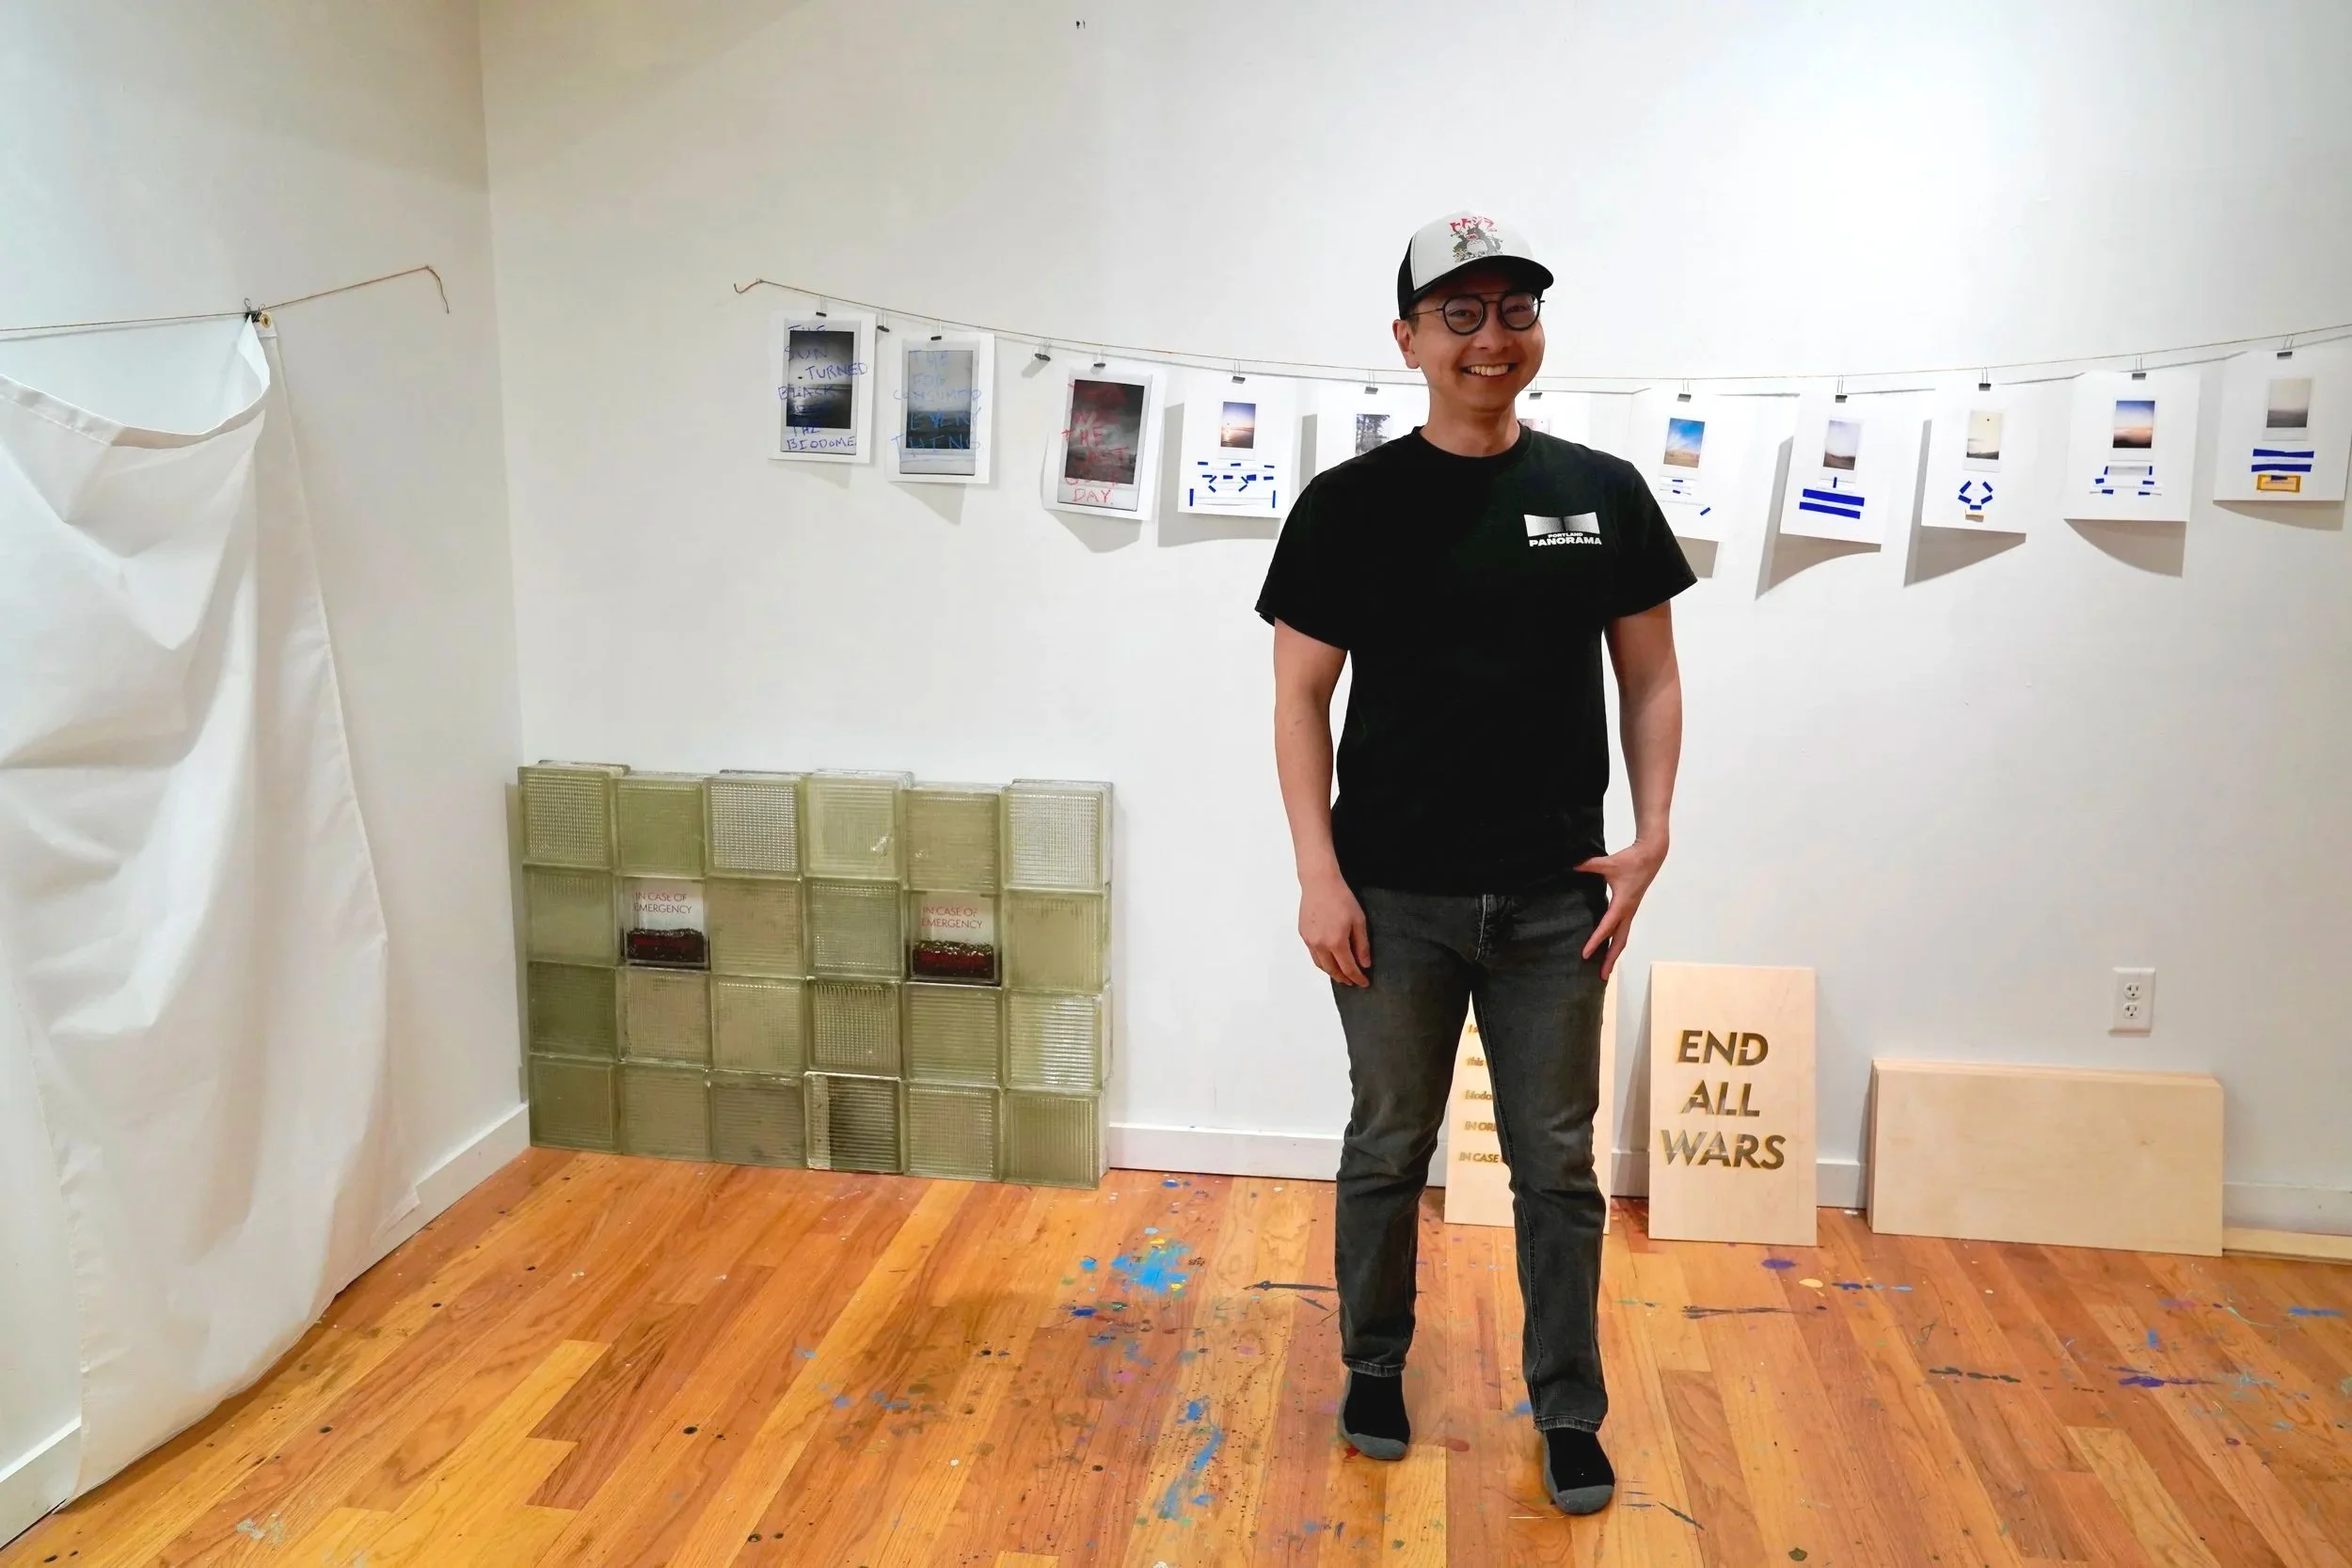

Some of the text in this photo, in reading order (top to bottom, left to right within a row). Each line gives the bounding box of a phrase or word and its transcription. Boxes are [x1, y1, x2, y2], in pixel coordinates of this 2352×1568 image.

[805, 362, 867, 380] TURNED
[1529, 536, 1602, 546] PANORAMA
[635, 892, 687, 902] IN CASE OF
[634, 903, 692, 914] EMERGENCY
[923, 906, 977, 917] IN CASE OF
[921, 917, 983, 928] EMERGENCY
[1677, 1029, 1769, 1066] END
[1467, 1056, 1484, 1066] this
[1680, 1080, 1760, 1117] ALL
[1661, 1130, 1787, 1170] WARS
[1473, 1153, 1500, 1163] CASE
